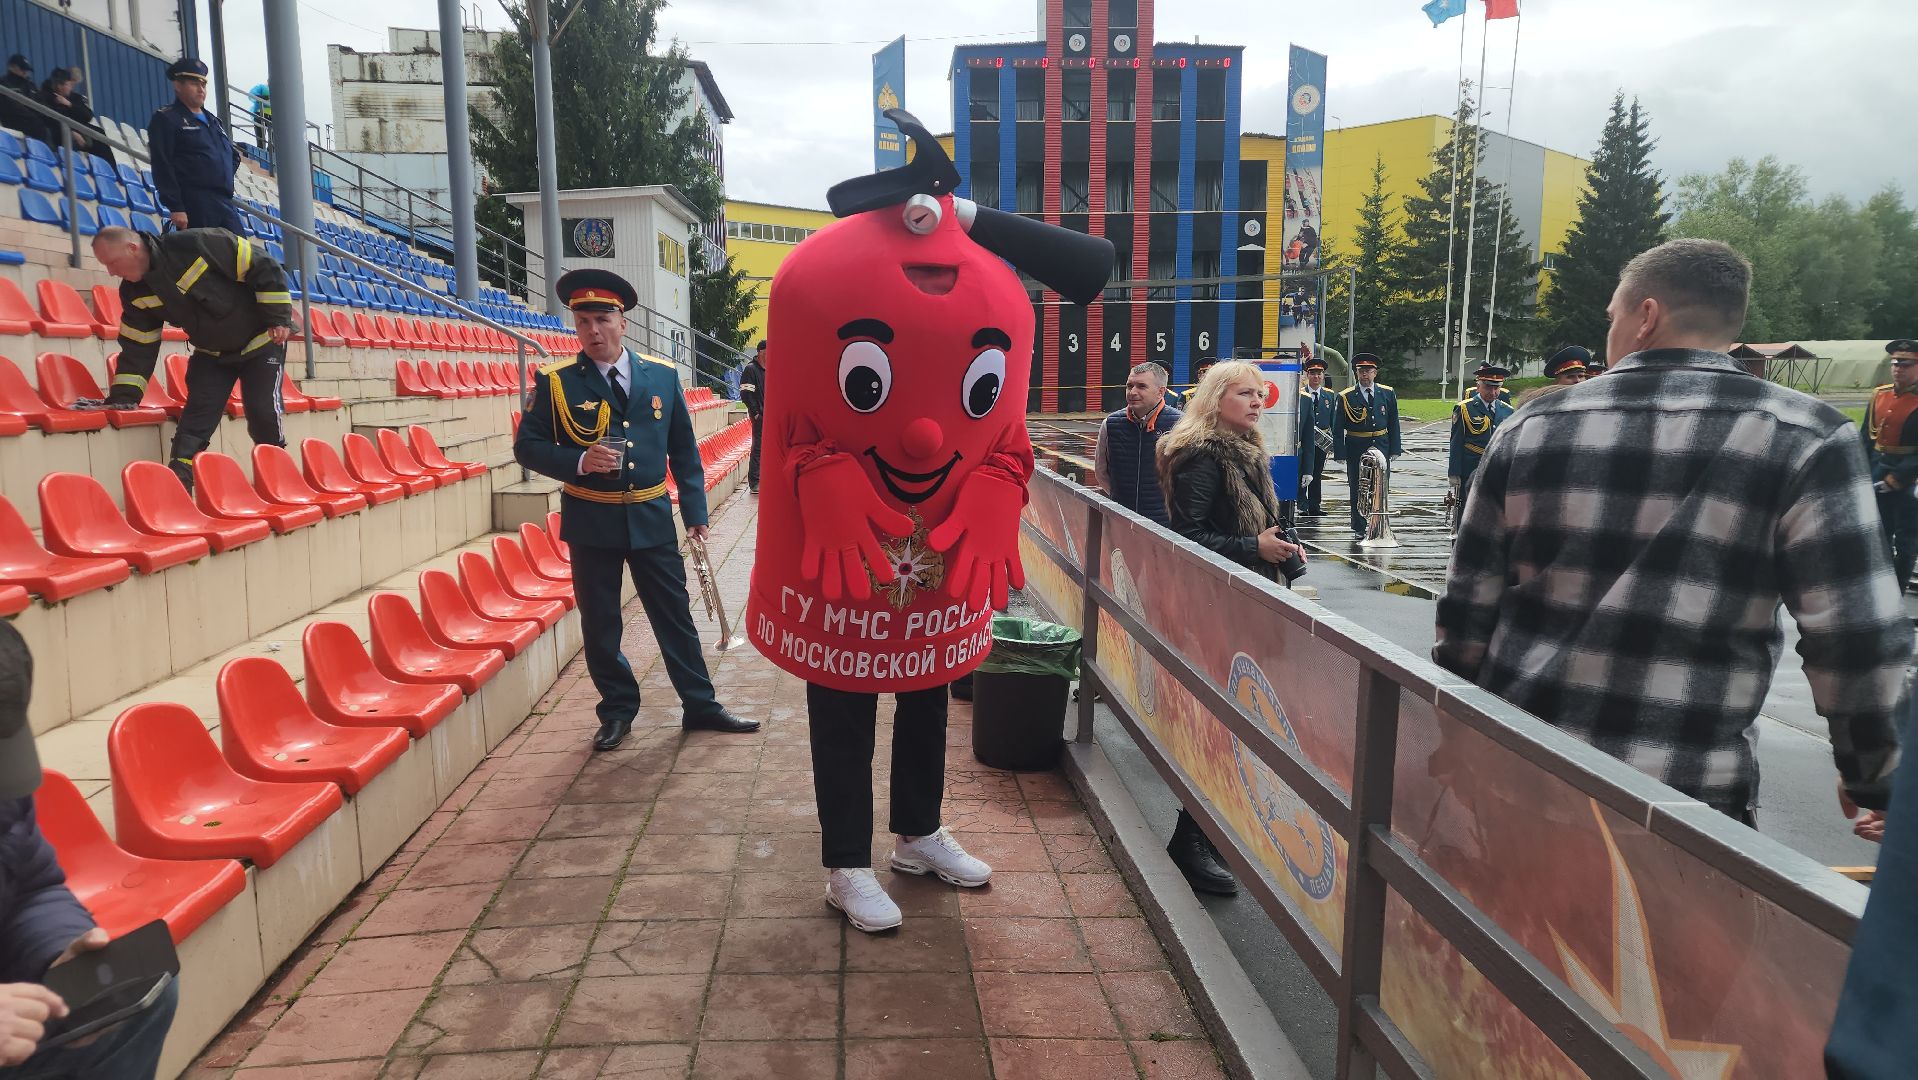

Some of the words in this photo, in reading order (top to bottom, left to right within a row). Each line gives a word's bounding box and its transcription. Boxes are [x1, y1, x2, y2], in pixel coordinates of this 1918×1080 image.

[1067, 333, 1079, 353] 3
[1110, 332, 1122, 352] 4
[1156, 332, 1167, 352] 5
[1198, 331, 1210, 351] 6
[781, 585, 814, 623] ГУ
[823, 603, 891, 640] МЧС
[904, 587, 991, 640] РОСС
[757, 612, 775, 646] ПО
[780, 628, 936, 679] МОСКОВСКОЙ
